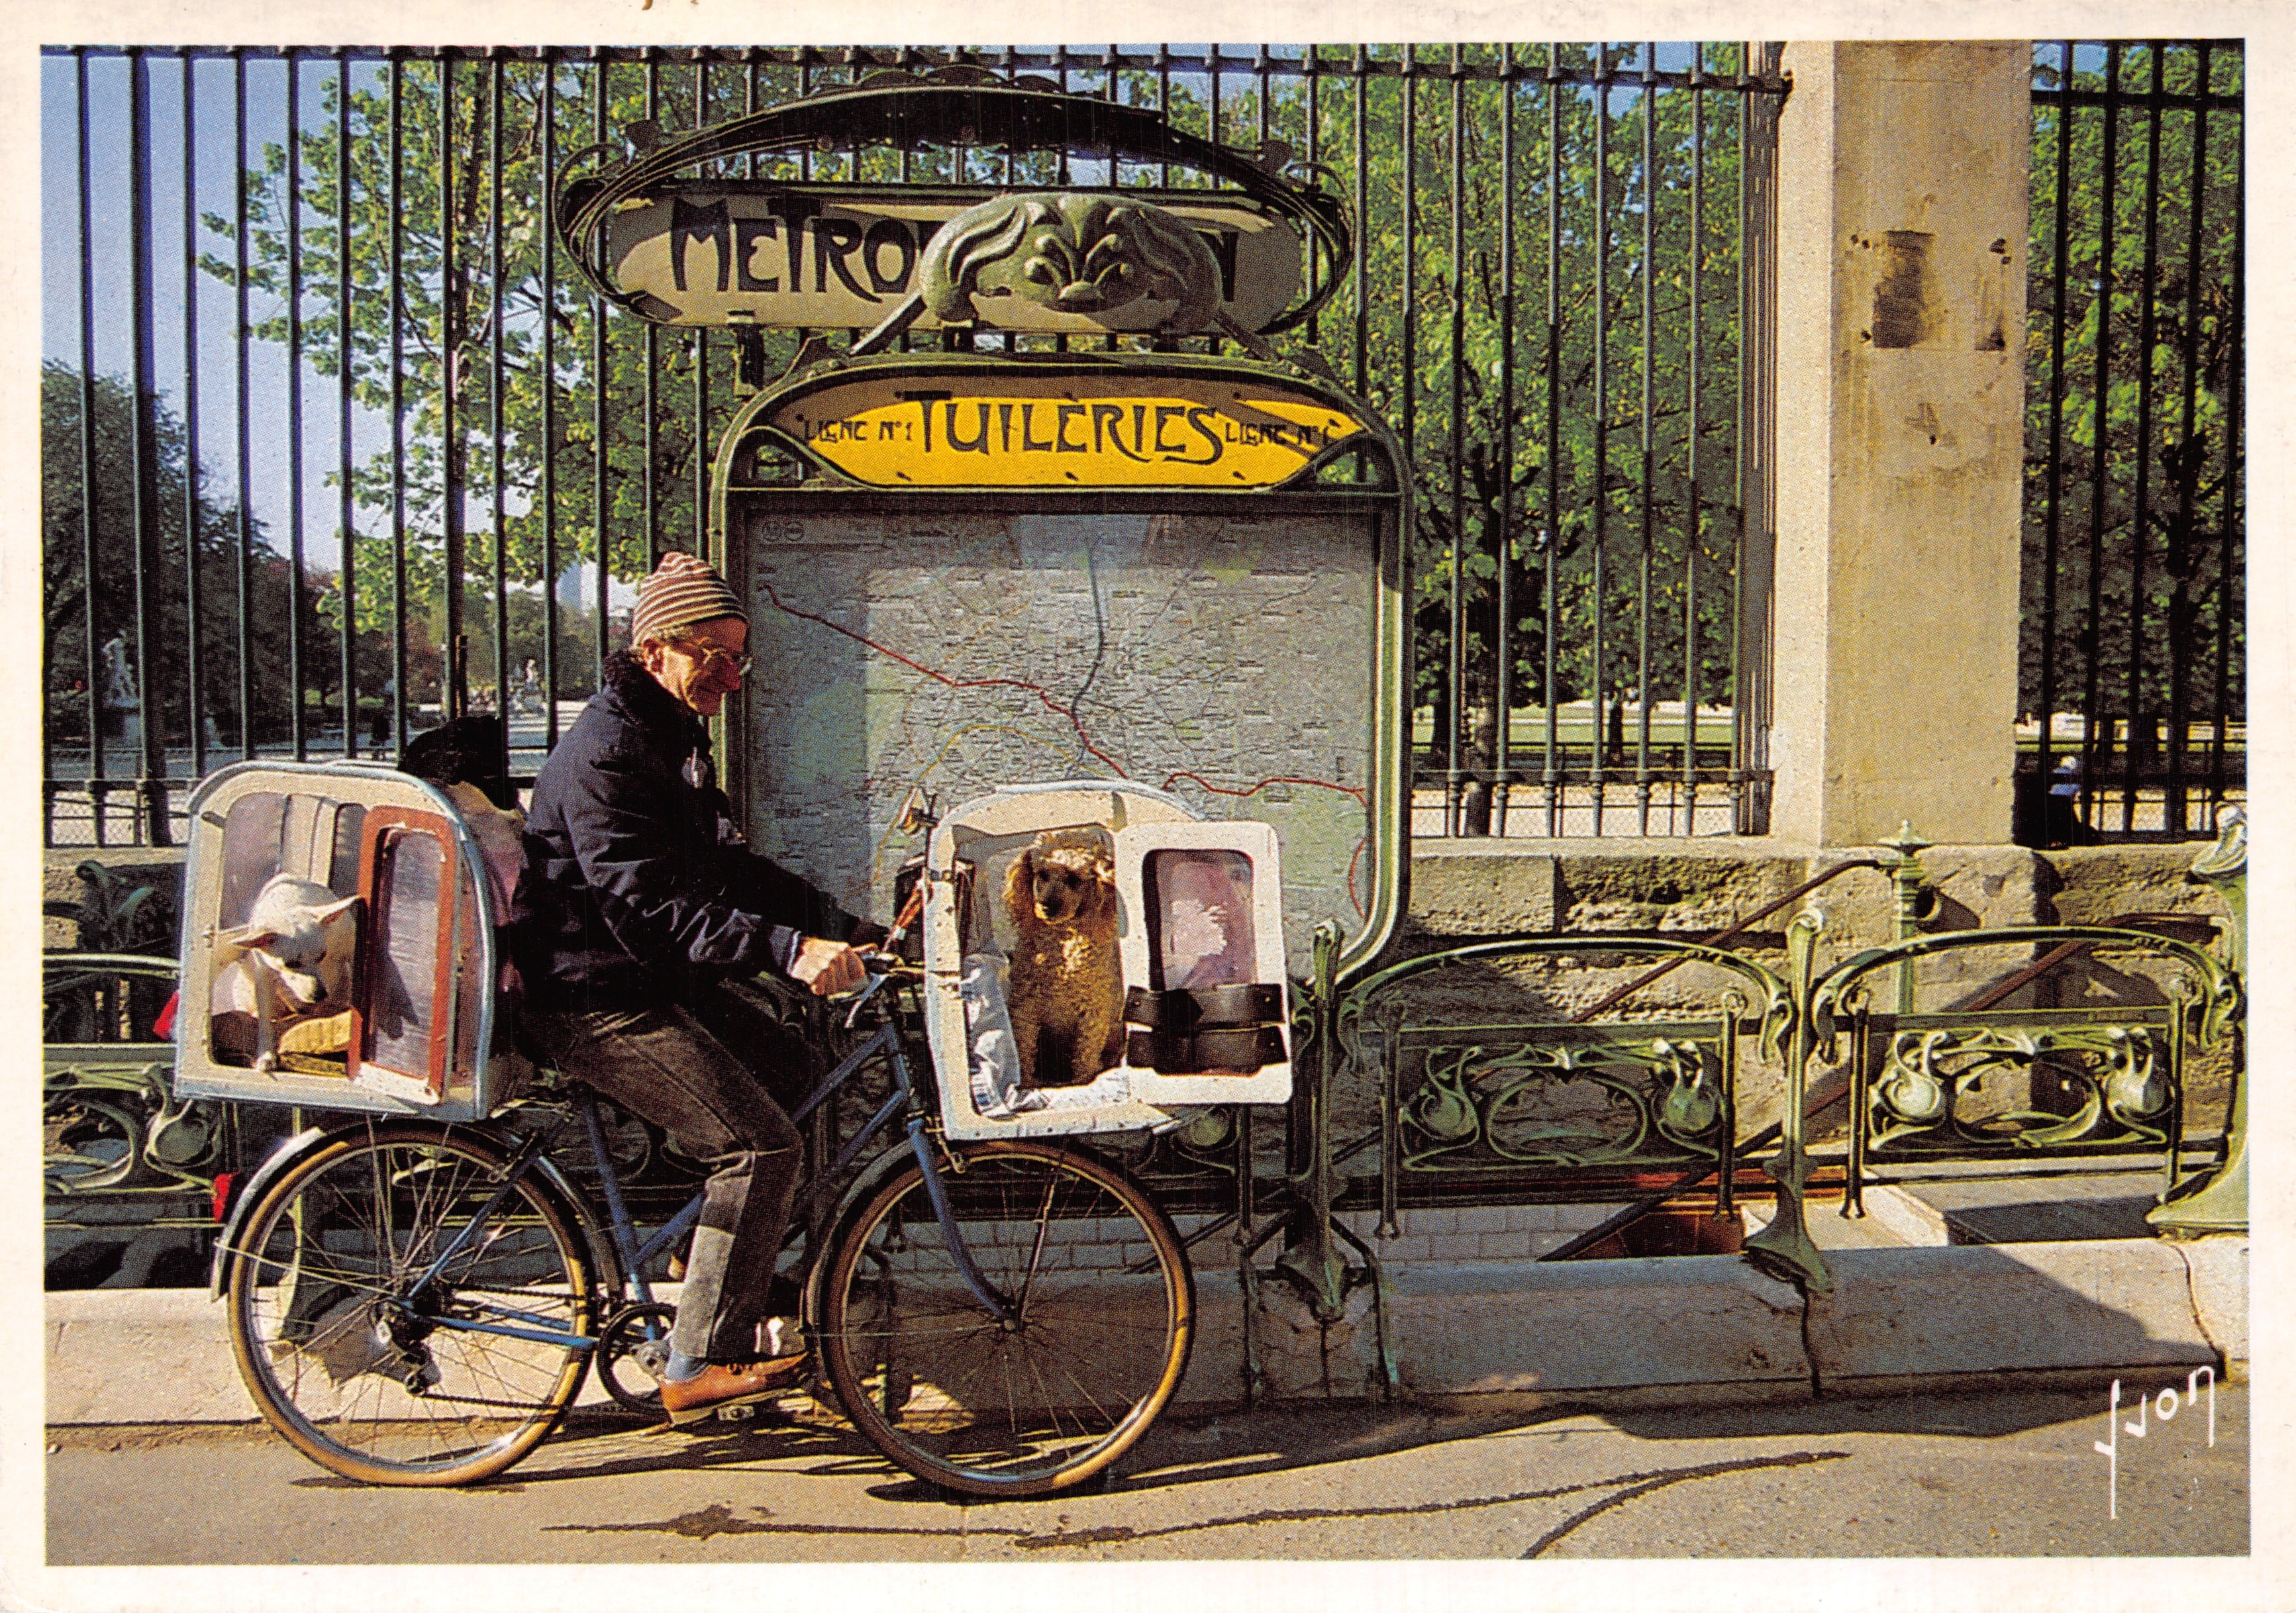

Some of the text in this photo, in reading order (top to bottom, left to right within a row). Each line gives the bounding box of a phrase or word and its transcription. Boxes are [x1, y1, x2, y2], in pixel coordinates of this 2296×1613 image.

[804, 420, 868, 443] LIGNE
[903, 391, 1223, 465] TUILERIES
[1225, 422, 1286, 446] LIGNE
